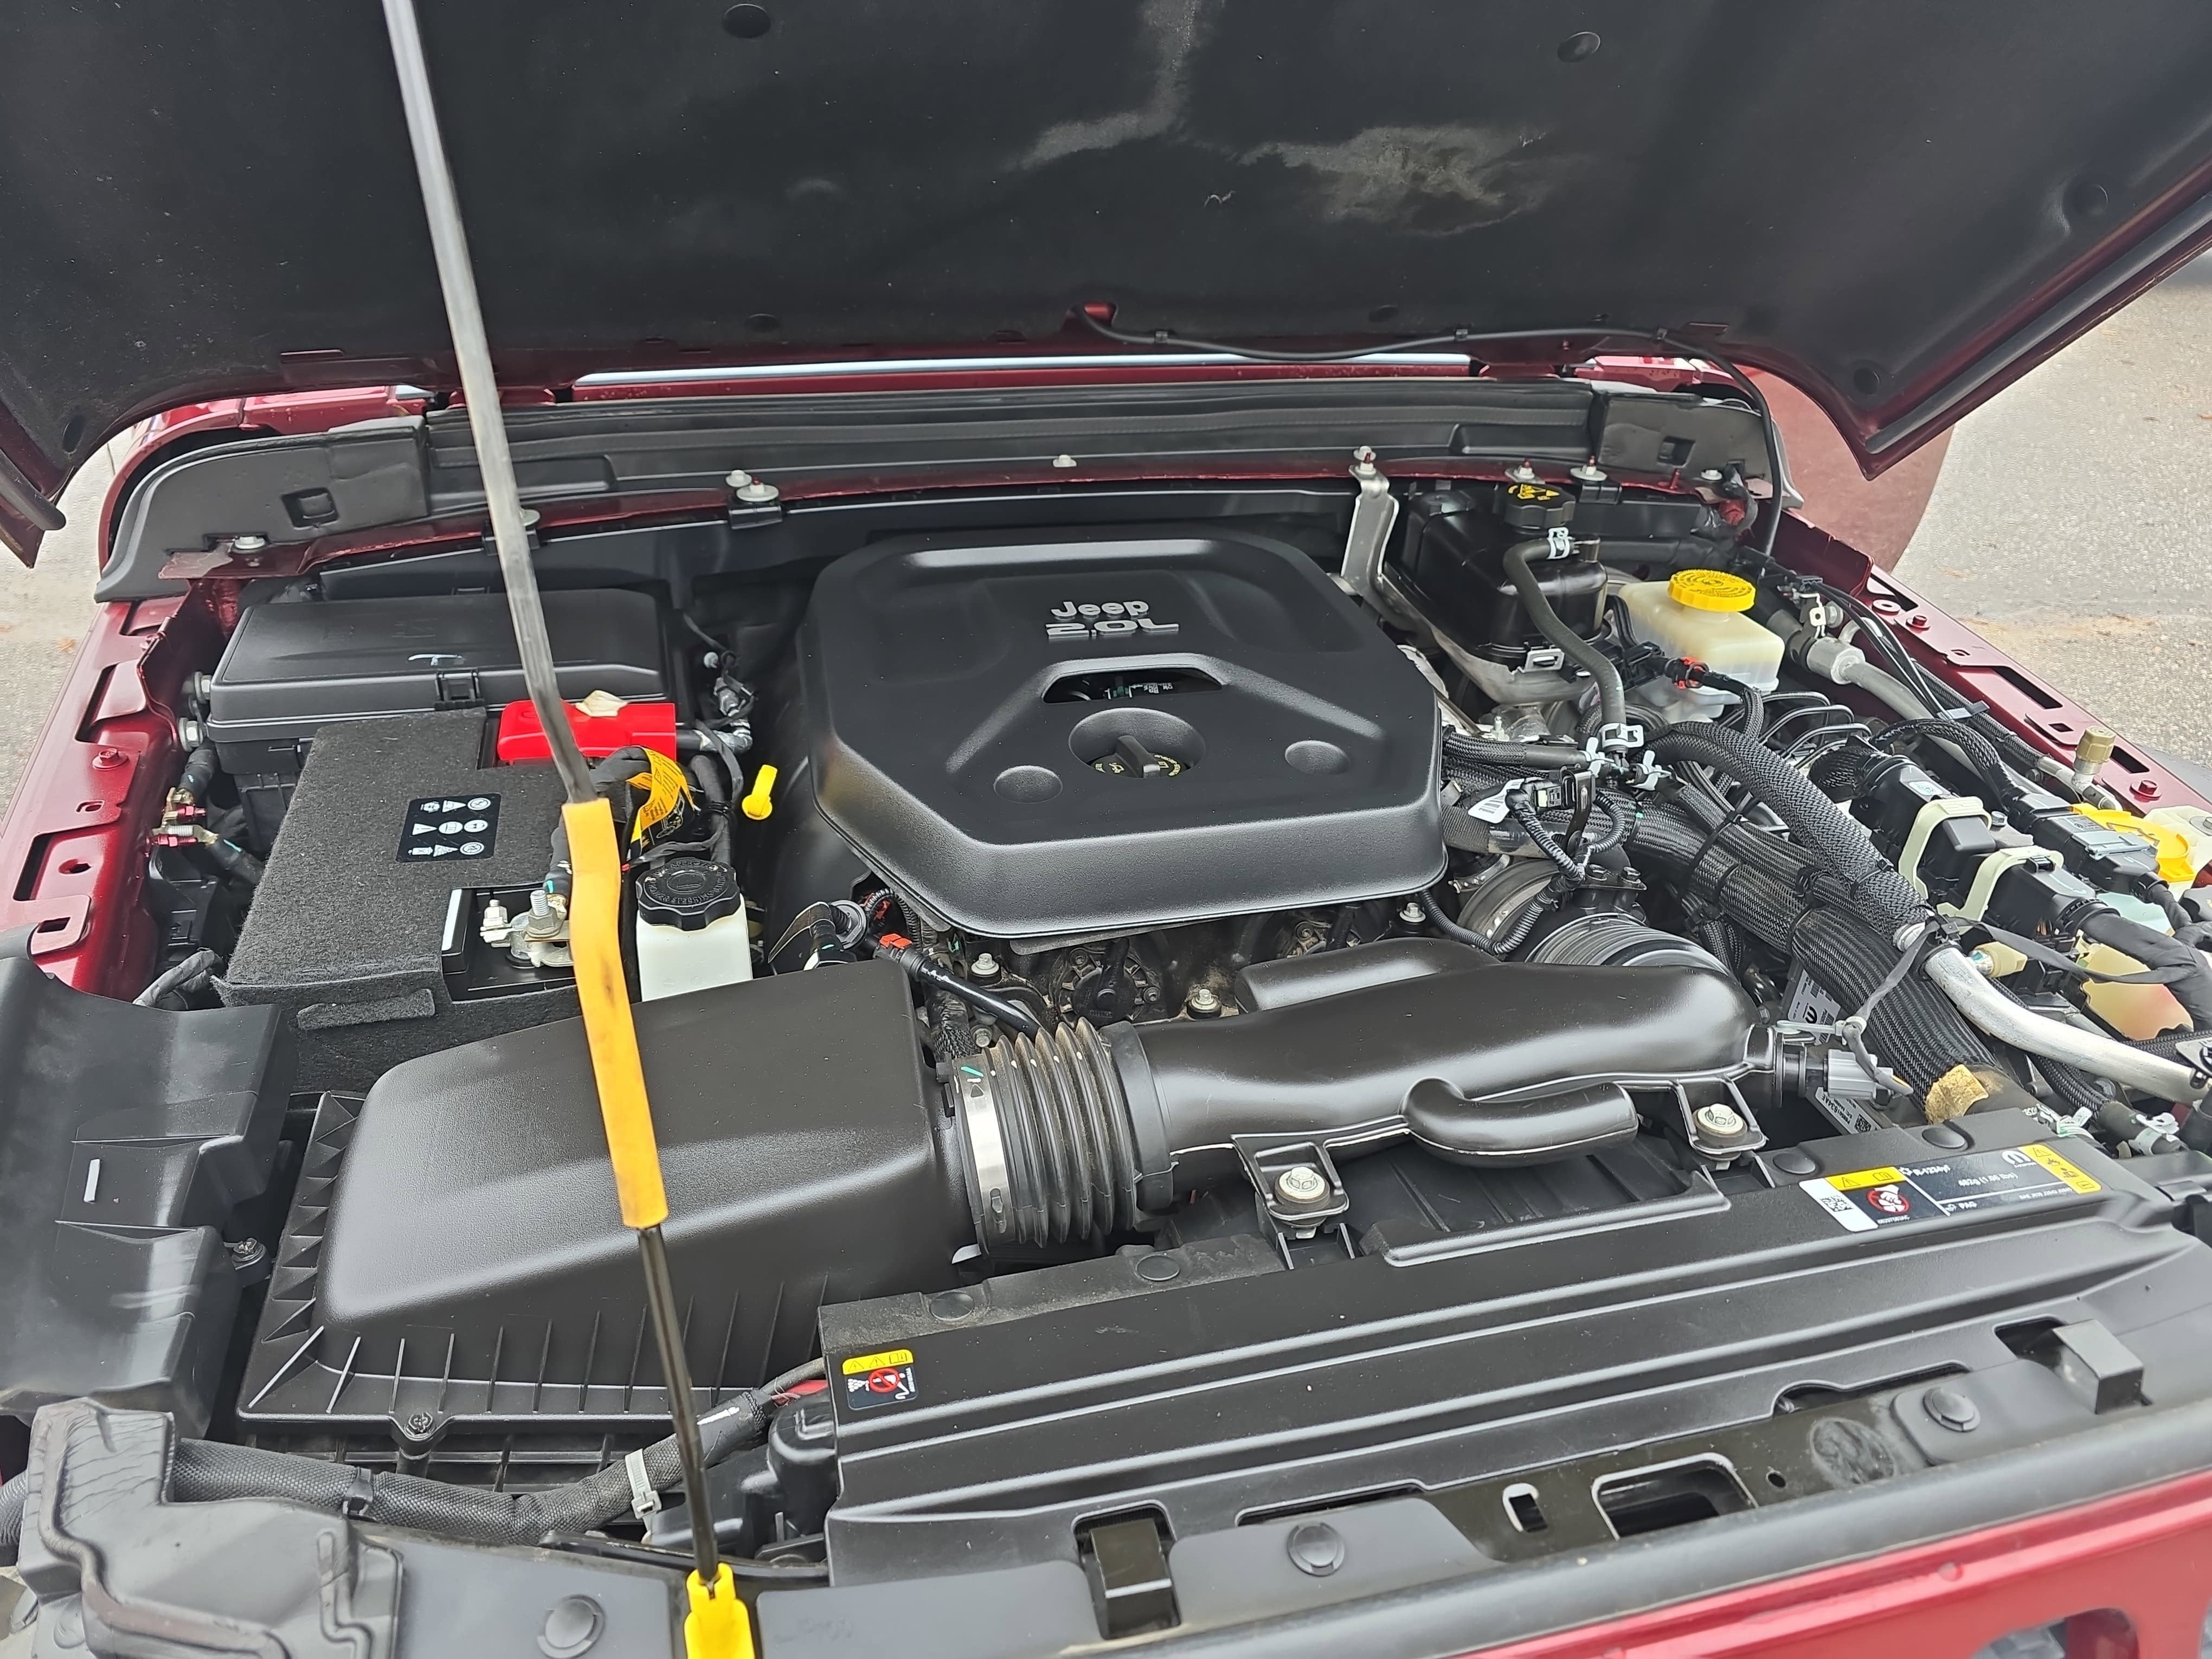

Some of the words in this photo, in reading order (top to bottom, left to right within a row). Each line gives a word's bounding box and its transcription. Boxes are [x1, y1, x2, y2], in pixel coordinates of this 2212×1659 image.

[1051, 600, 1149, 617] Jeep
[1045, 618, 1179, 638] 2.0L
[1958, 1201, 1977, 1210] PAG
